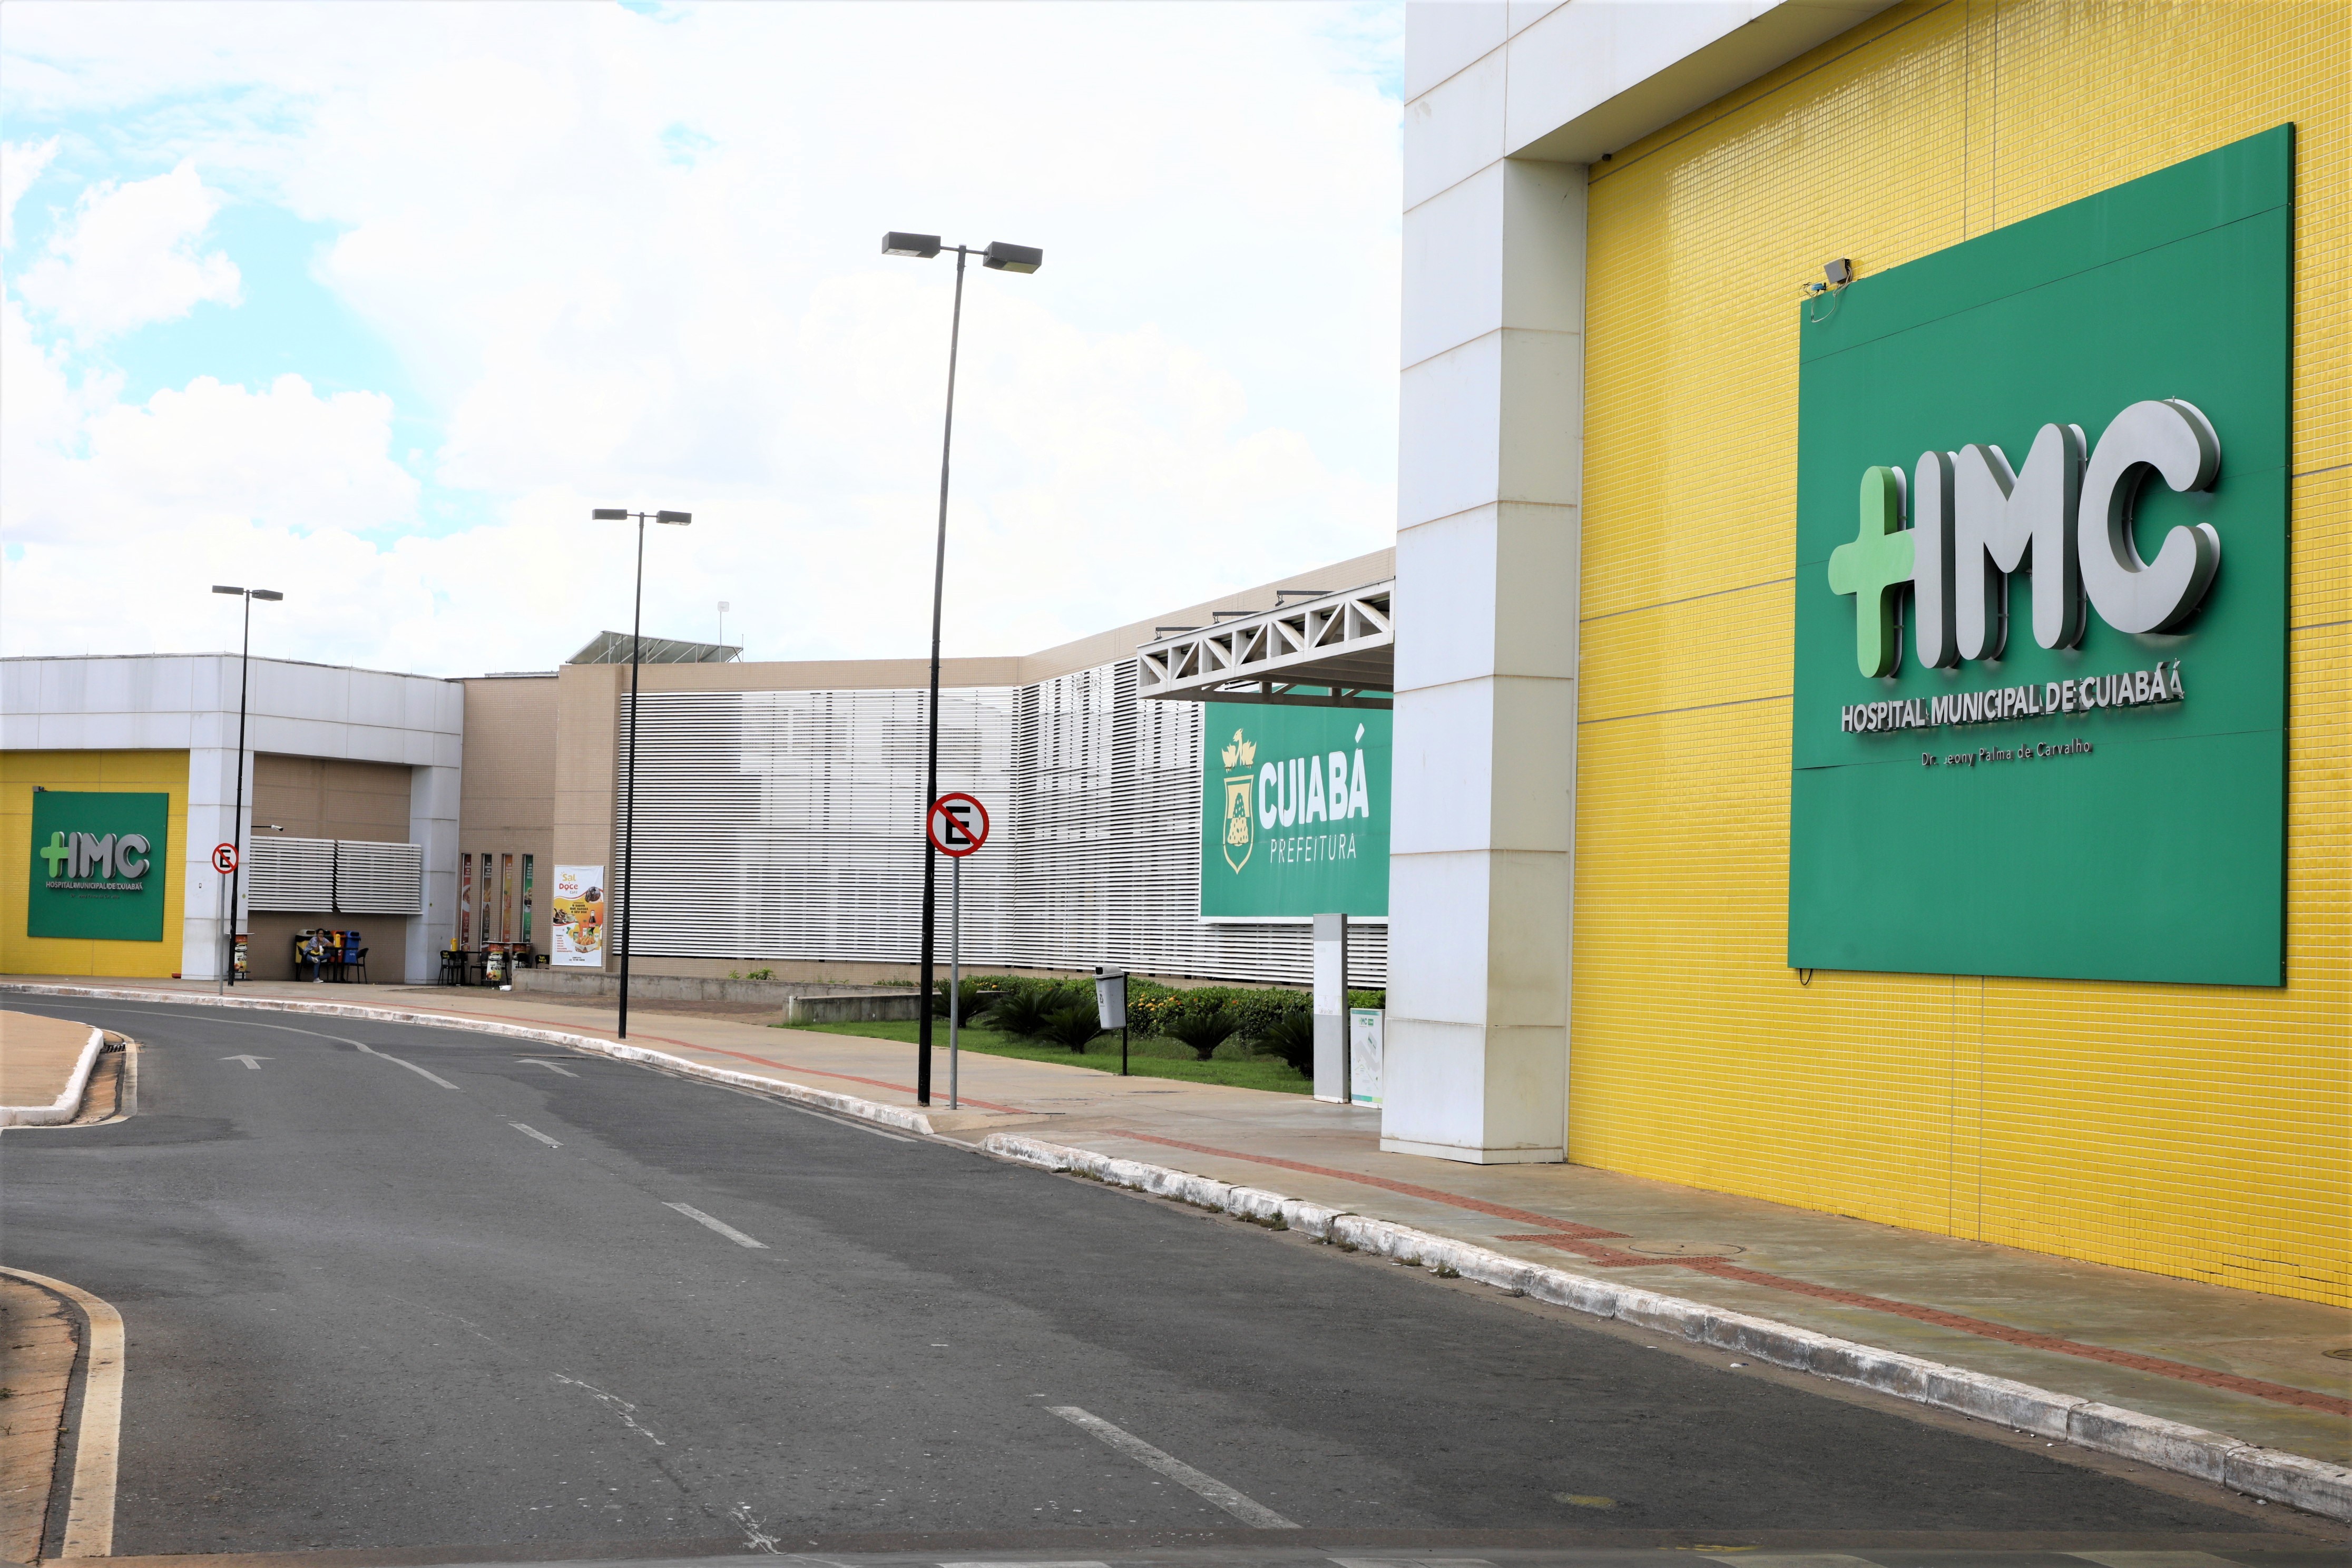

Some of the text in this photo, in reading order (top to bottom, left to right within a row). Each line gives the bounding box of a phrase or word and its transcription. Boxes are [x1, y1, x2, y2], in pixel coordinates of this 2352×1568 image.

[1841, 660, 2181, 732] HOSPITAL MUNICIPAL DE CUIABÁ
[1922, 752, 1937, 766] Dr.
[1979, 747, 2014, 762] Palma
[2017, 743, 2033, 759] de
[2037, 738, 2093, 758] Carvalho
[1258, 722, 1369, 830] CUIABÁ
[1270, 832, 1356, 864] PREFEITURA
[46, 881, 74, 889] HOSPITAL
[562, 873, 576, 881] Sal
